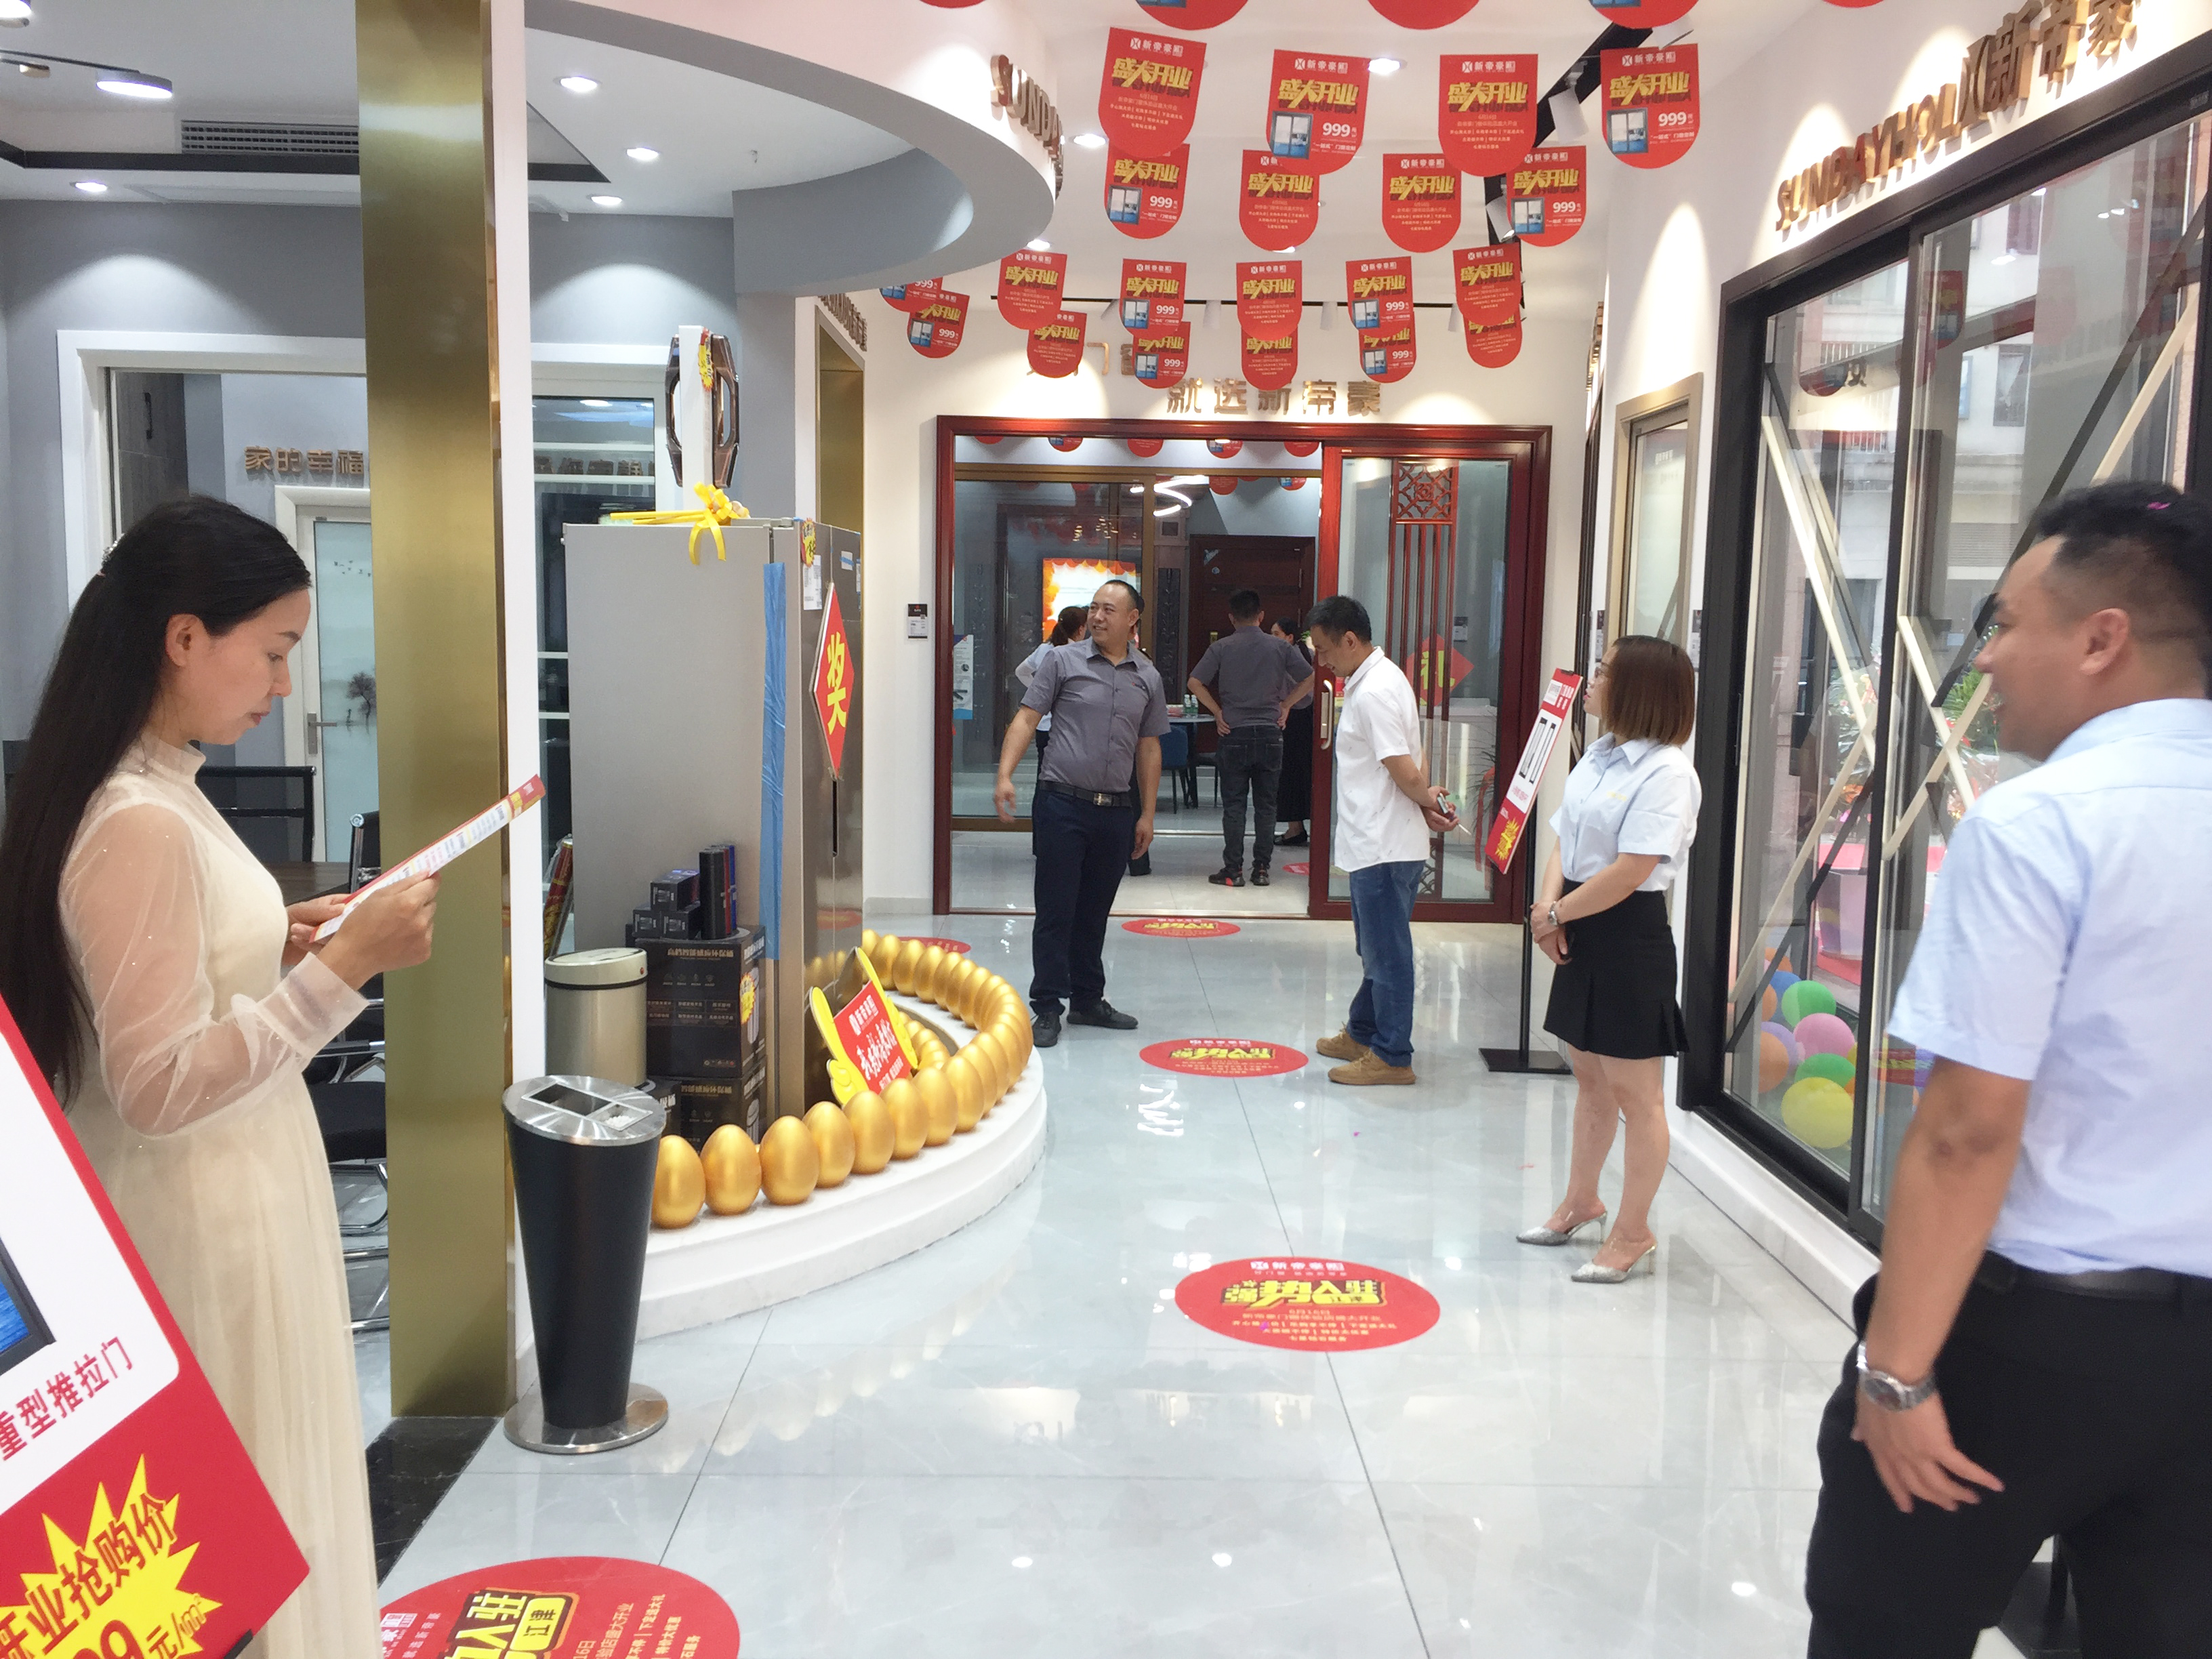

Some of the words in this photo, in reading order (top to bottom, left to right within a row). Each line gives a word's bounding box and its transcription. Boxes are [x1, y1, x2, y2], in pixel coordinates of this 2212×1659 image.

[1111, 57, 1193, 90] 盛大开业
[1277, 79, 1359, 108] 盛大开业
[1448, 81, 1528, 112] 盛大开业
[1610, 72, 1690, 106] 盛大开业
[1658, 112, 1687, 127] 999
[1322, 123, 1351, 138] 999
[1114, 159, 1180, 184] 盛大开业
[1513, 169, 1579, 195] 盛大开业
[1248, 173, 1313, 197] 盛大开业
[1389, 176, 1455, 201] 盛大开业
[1149, 195, 1173, 209] 999
[1553, 201, 1576, 213] 999
[1005, 266, 1059, 286] 盛大开业
[1460, 262, 1513, 286] 盛大开业
[1126, 277, 1179, 297] 盛大开业
[1242, 279, 1295, 300] 盛大开业
[1353, 275, 1406, 298] 盛大开业
[916, 304, 962, 321] 大开业
[1156, 305, 1174, 315] 999
[1386, 301, 1405, 311] 999
[939, 328, 956, 339] 999
[1164, 359, 1181, 367] 999
[1392, 350, 1409, 359] 999
[245, 445, 365, 475] 家的幸福
[0, 1336, 133, 1462] 重型推拉门
